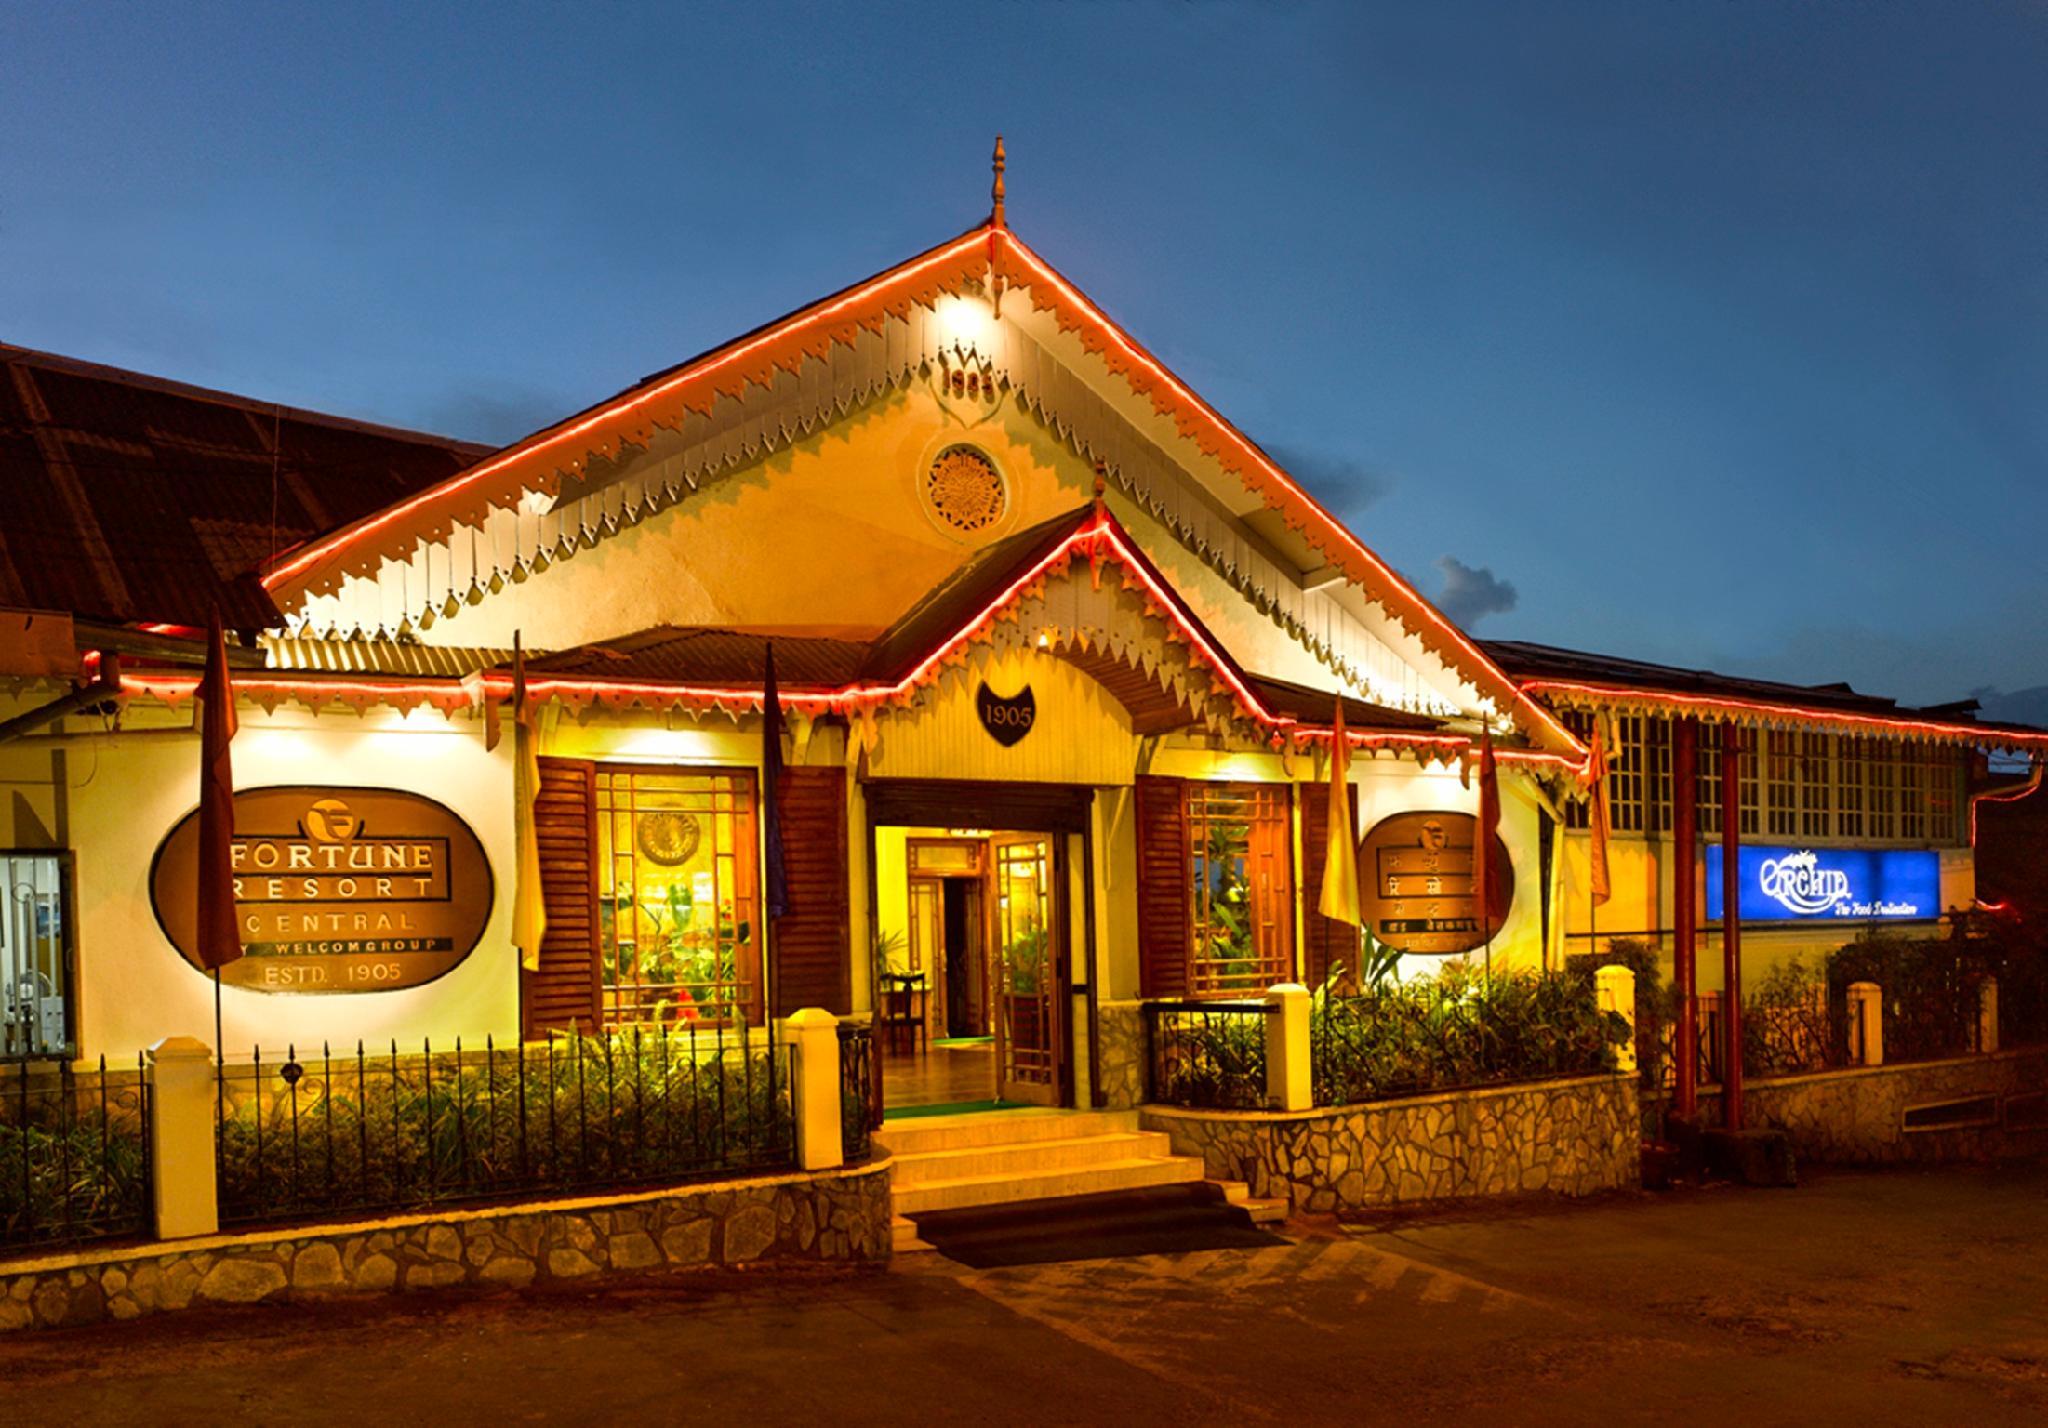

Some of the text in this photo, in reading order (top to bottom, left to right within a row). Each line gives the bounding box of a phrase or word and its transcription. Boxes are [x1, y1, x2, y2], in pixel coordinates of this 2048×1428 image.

[986, 704, 1032, 727] 1905
[229, 843, 433, 869] FORTUNE
[232, 878, 433, 899] RESORT
[1760, 855, 1851, 906] ORCHID
[246, 912, 416, 932] CENTRAL
[275, 939, 436, 955] WELCOMGROUP
[264, 963, 402, 985] ESTD. 1905
